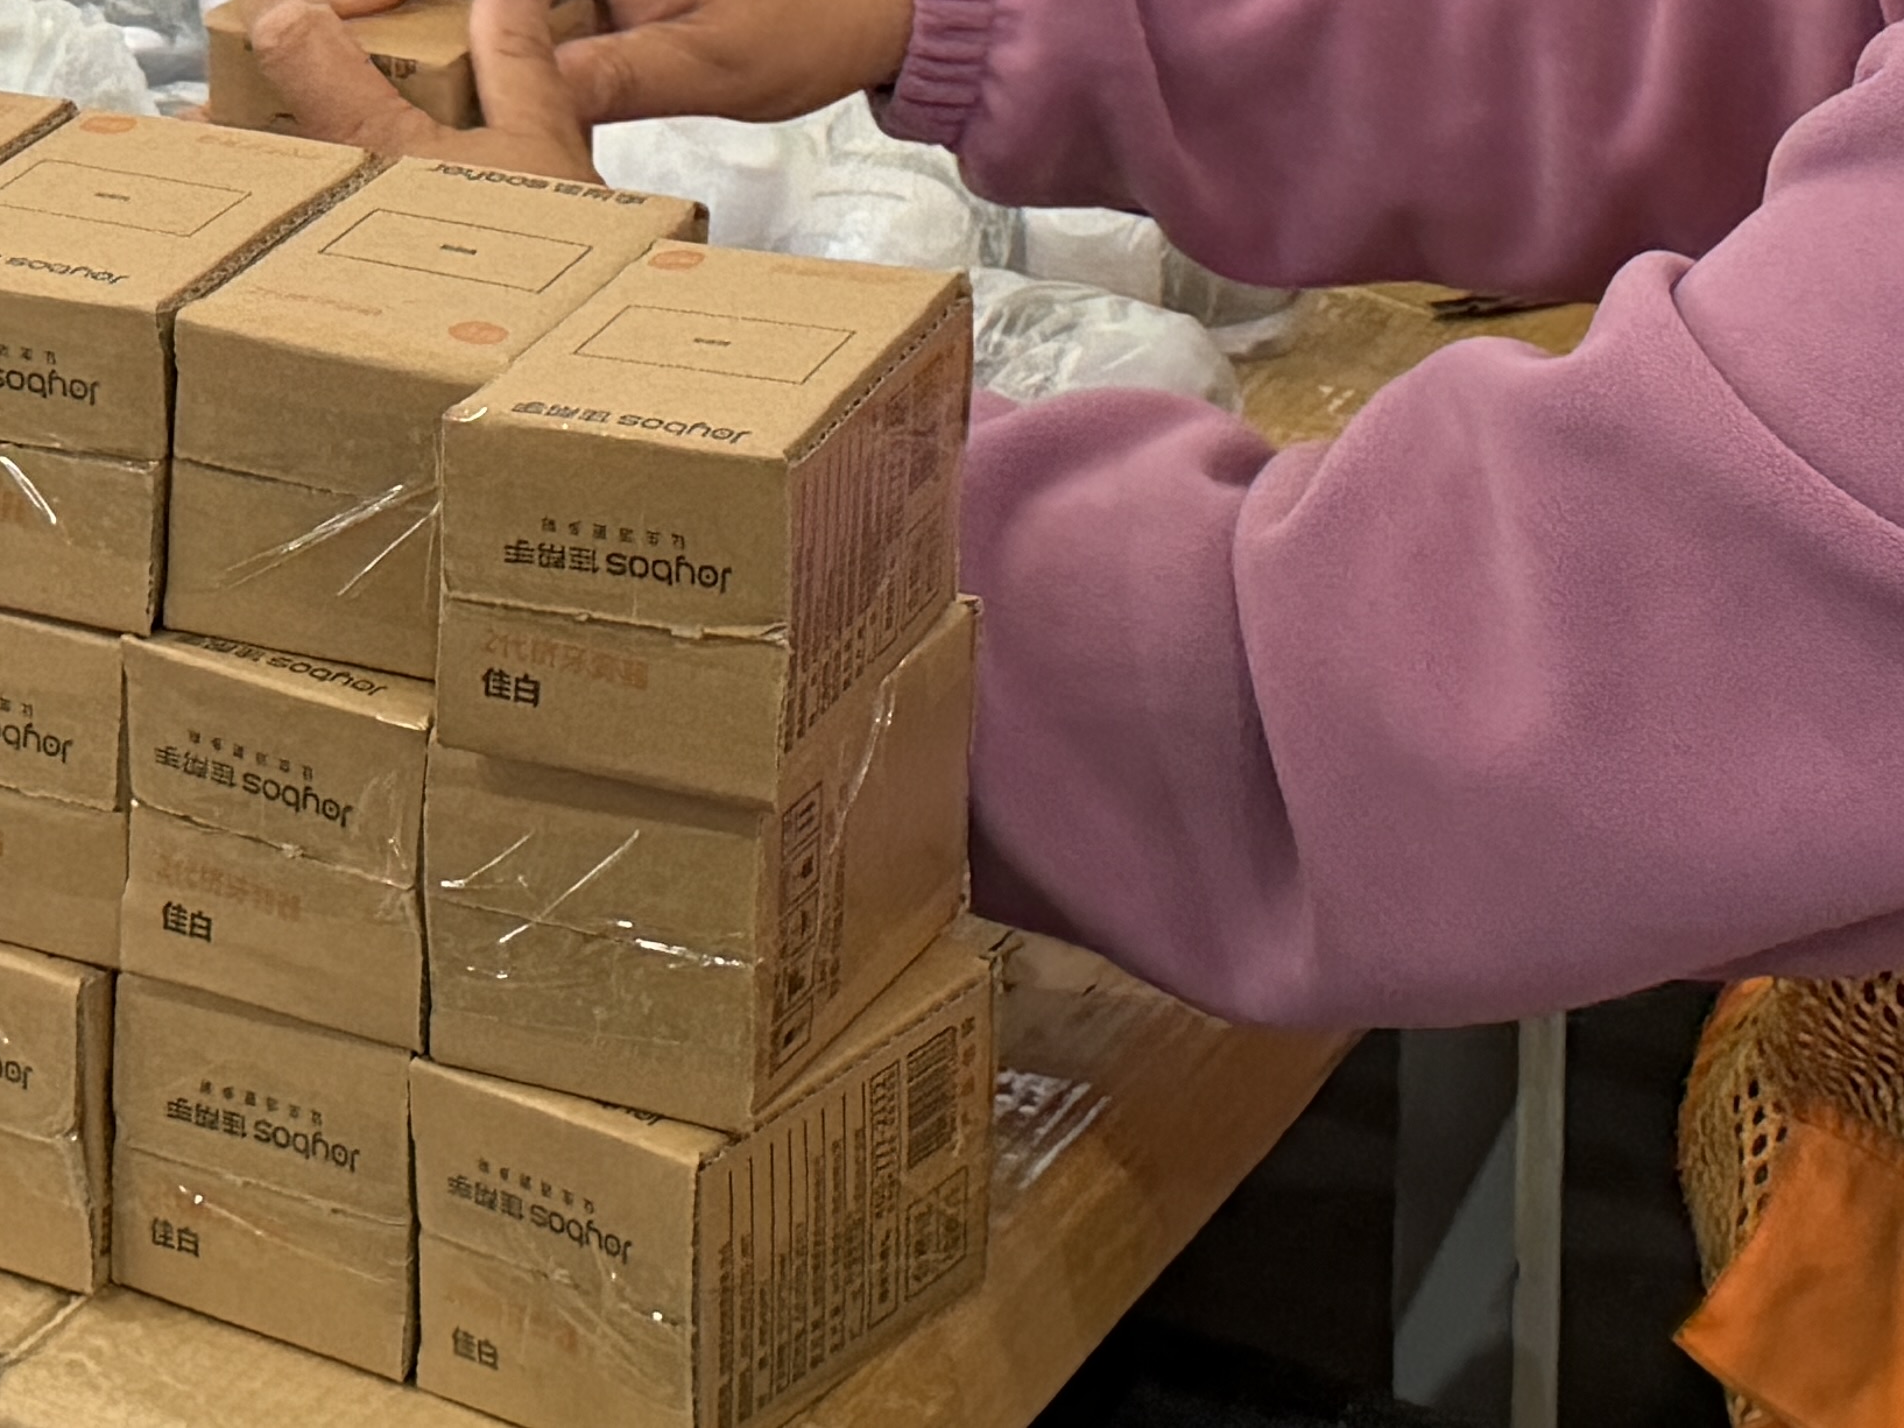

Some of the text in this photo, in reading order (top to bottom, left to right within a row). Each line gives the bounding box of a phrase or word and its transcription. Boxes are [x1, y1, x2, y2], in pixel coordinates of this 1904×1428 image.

[504, 539, 733, 595] Joybos 佳帮手
[482, 666, 541, 708] 佳白
[242, 771, 354, 828] Joybos
[162, 900, 213, 944] 佳白
[254, 1118, 361, 1173] Joybos
[152, 1217, 200, 1258] 佳白
[530, 1203, 633, 1266] Joybos
[452, 1325, 500, 1372] 佳白
